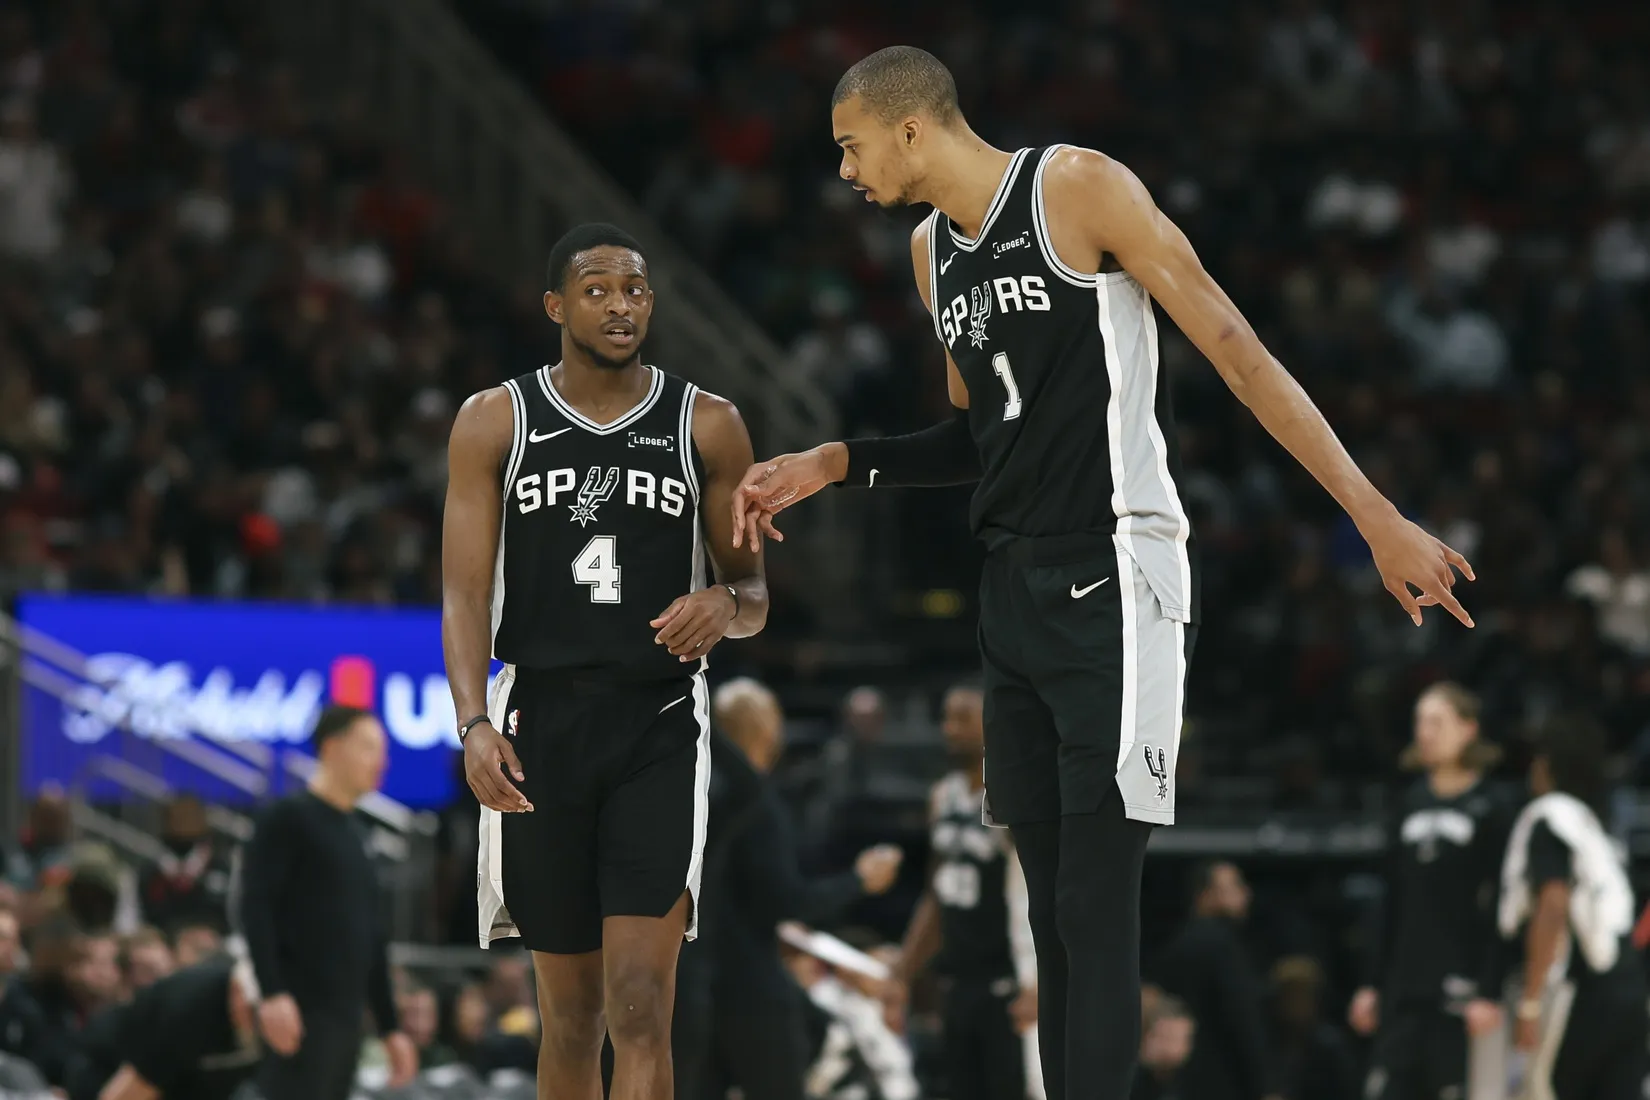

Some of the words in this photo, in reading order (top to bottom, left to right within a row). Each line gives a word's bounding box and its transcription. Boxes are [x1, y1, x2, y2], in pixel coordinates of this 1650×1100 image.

[996, 237, 1026, 253] LEDGER
[992, 351, 1022, 421] 1
[633, 436, 668, 447] LEDGER
[571, 535, 621, 603] 4
